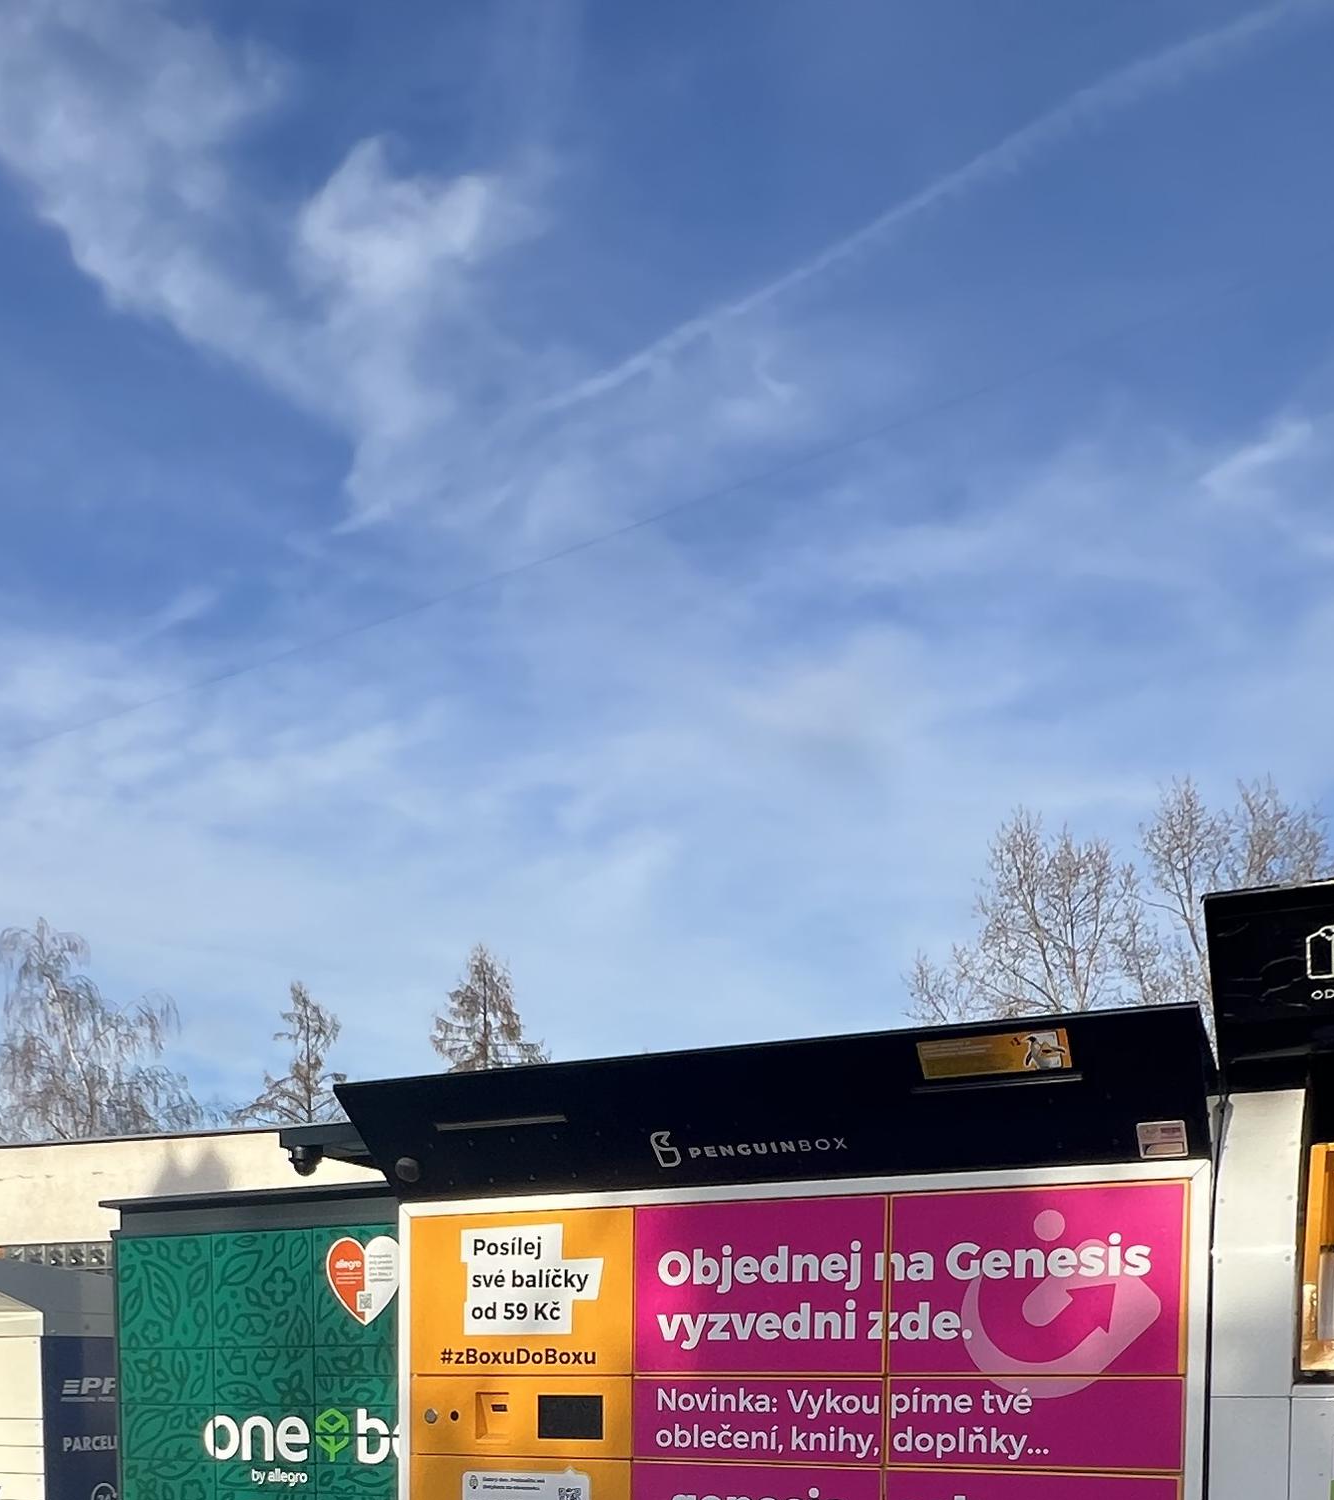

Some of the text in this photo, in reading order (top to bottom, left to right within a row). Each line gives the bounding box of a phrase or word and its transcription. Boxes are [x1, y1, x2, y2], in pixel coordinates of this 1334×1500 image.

[688, 1137, 848, 1158] PENGUINBOX
[473, 1236, 542, 1260] Posílej
[657, 1232, 1152, 1294] Objednej na Genesis
[472, 1268, 589, 1292] své balíčky
[471, 1301, 561, 1320] od 59 Kč
[656, 1299, 973, 1350] vyzvedni zde.
[440, 1348, 597, 1365] #zBoxuDoBoxu
[657, 1387, 778, 1413] Novinka:
[982, 1387, 1033, 1414] tvé
[63, 1434, 117, 1452] PARCEL
[204, 1414, 310, 1462] one
[655, 1424, 1049, 1460] oblečení, knihy, doplňky...
[251, 1468, 308, 1486] by allegro
